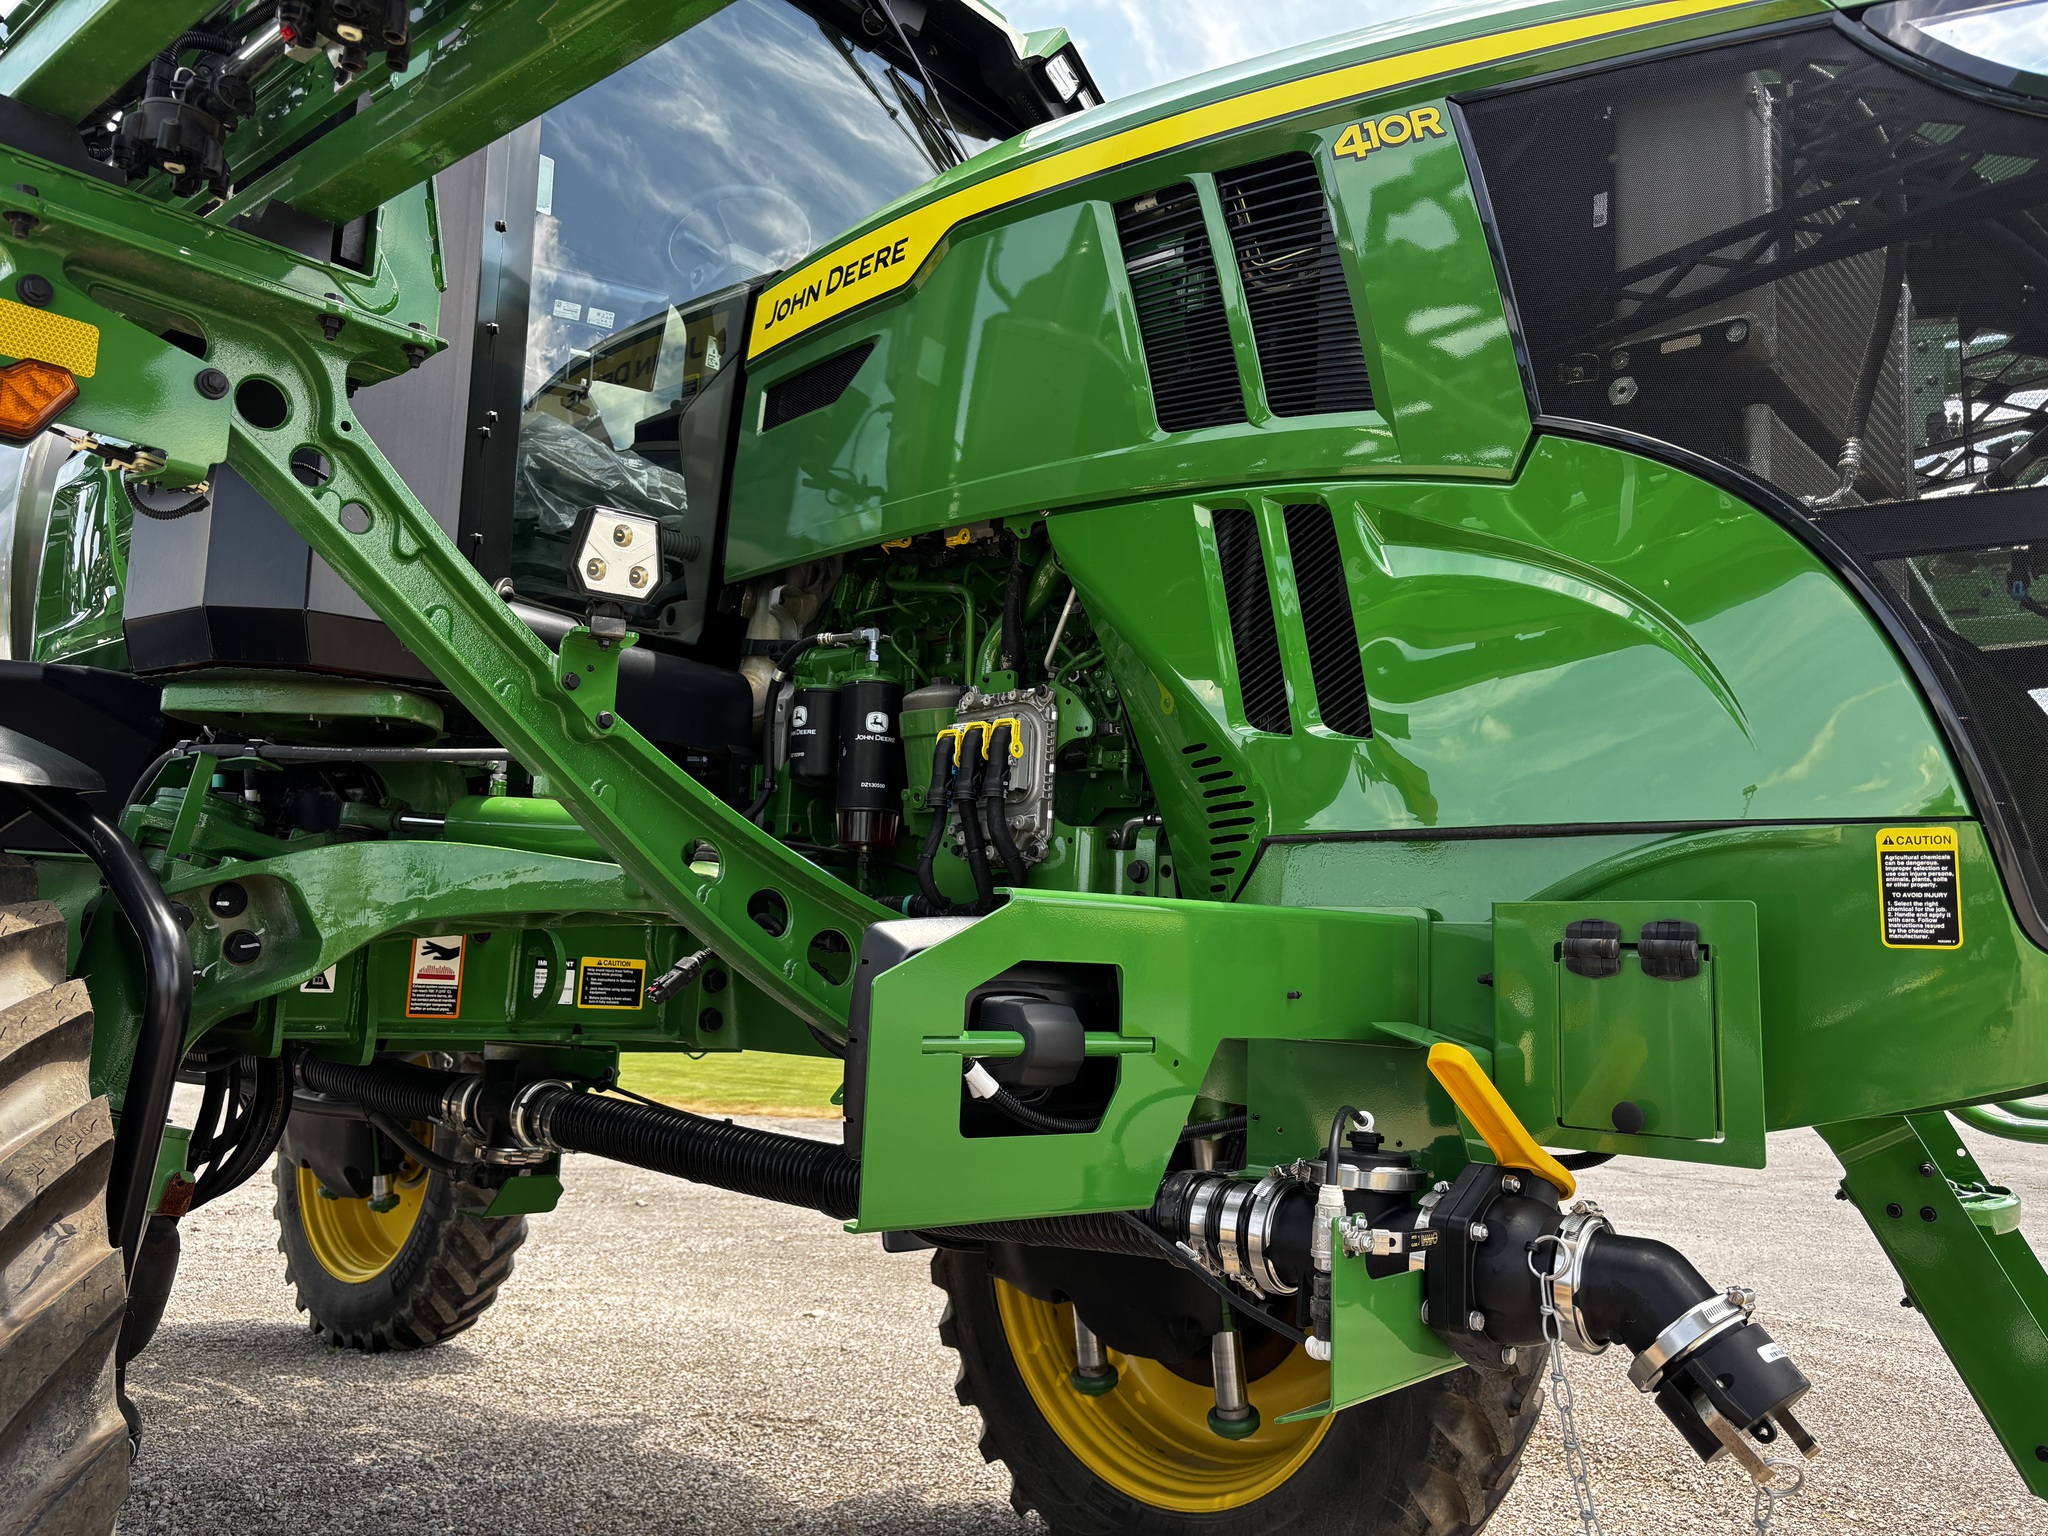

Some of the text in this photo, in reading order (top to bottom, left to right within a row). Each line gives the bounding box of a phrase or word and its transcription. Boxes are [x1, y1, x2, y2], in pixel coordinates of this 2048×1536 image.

[1333, 106, 1447, 161] 410R
[765, 236, 909, 330] JOHN DEERE
[875, 734, 895, 743] DEERE
[1896, 835, 1952, 845] CAUTION
